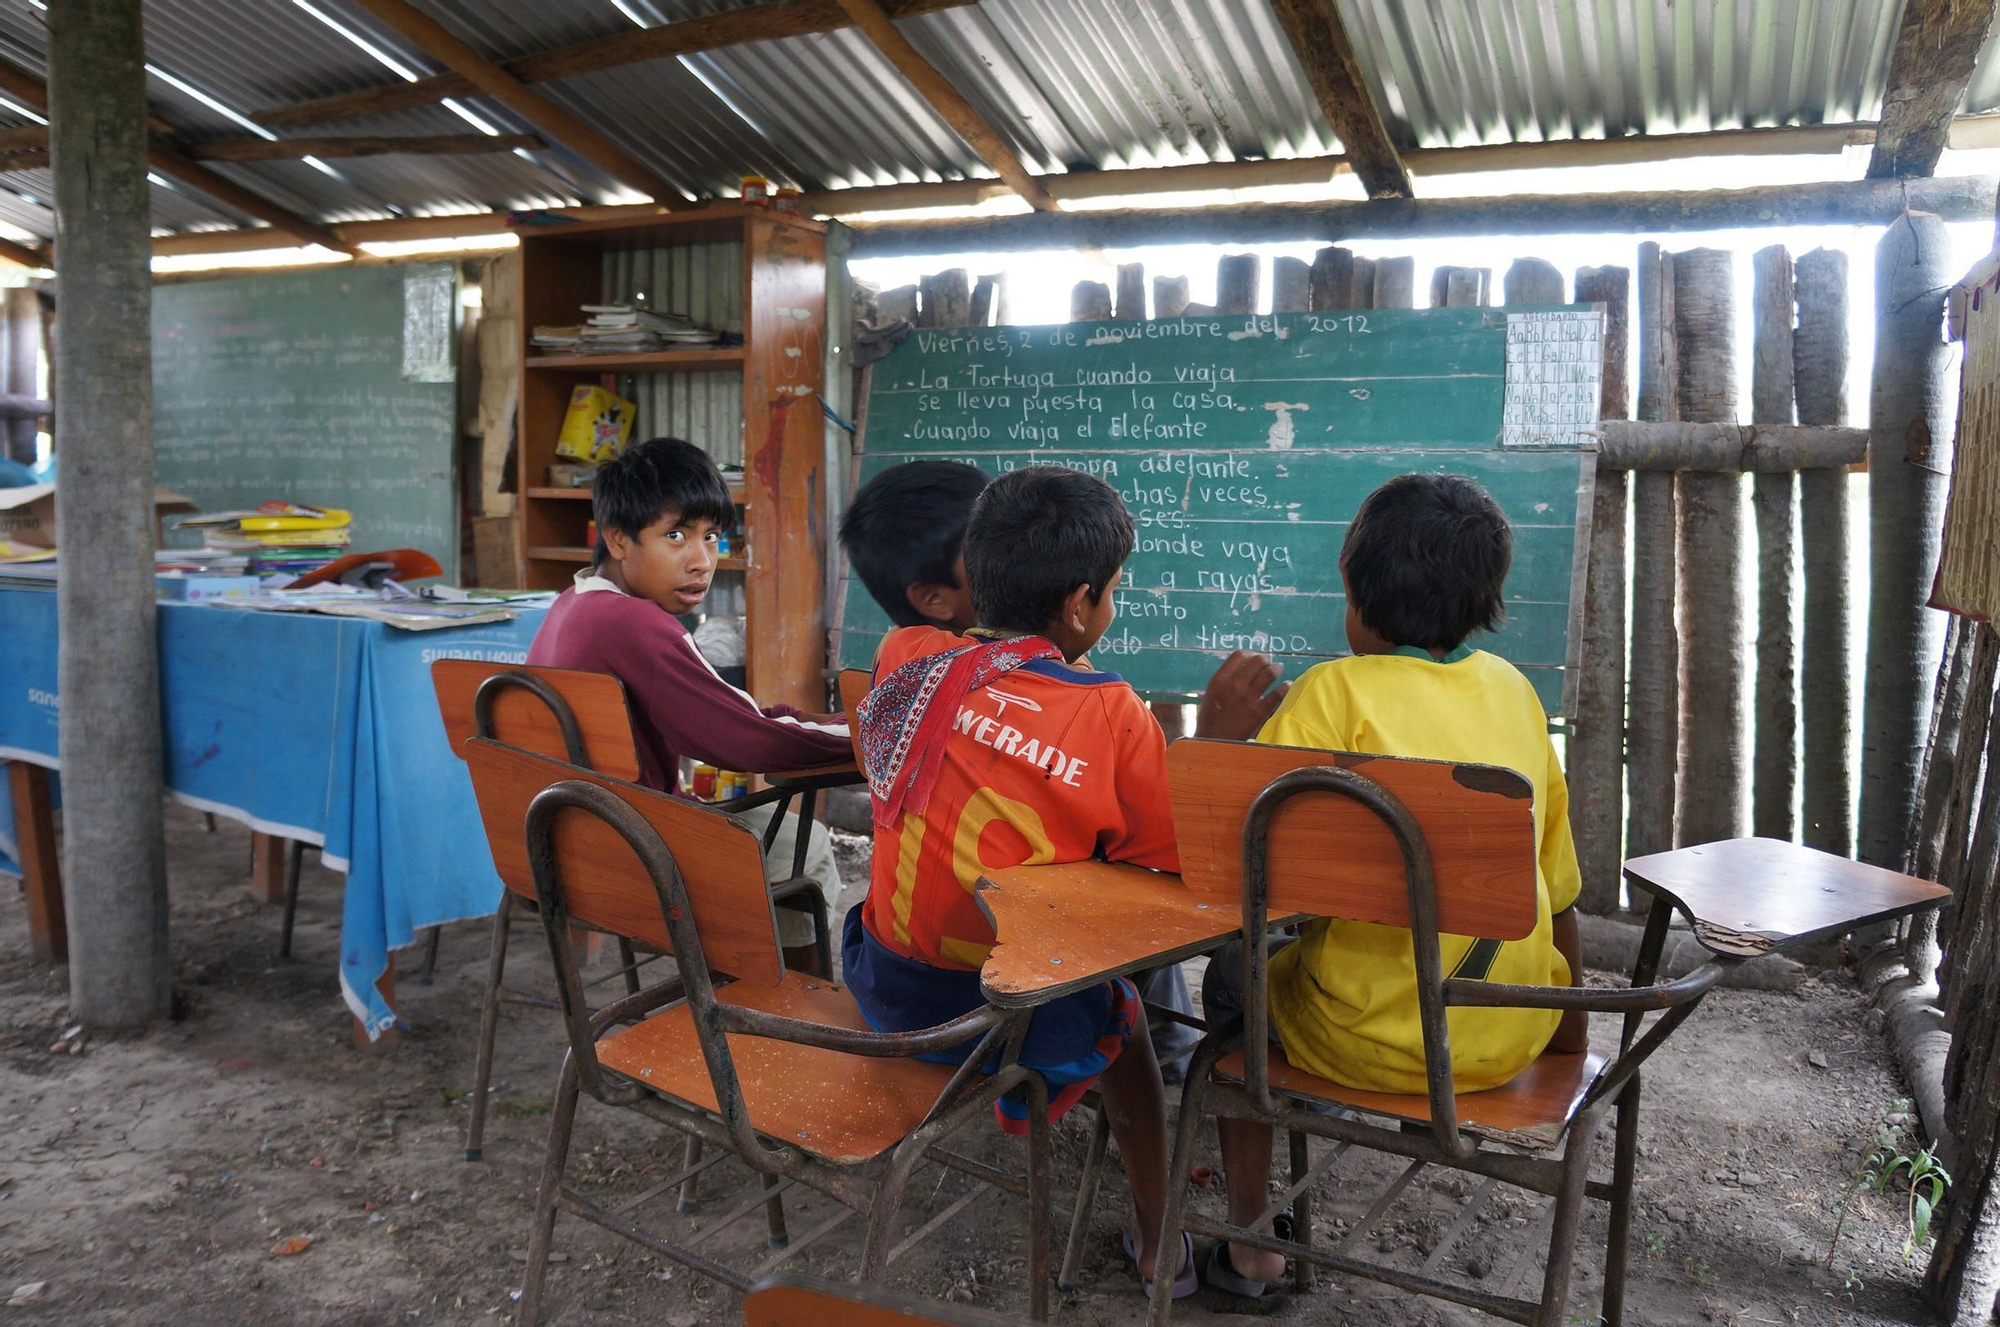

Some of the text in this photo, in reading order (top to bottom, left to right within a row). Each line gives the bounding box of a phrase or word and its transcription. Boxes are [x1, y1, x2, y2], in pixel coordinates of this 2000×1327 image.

[918, 314, 1371, 357] Viernes, 2 de noviembre del 2012
[969, 364, 1054, 399] Tortuga
[1077, 362, 1151, 386] cuando
[1174, 362, 1235, 392] viaja
[919, 394, 941, 411] se
[957, 391, 1010, 410] lleva
[1023, 389, 1102, 421] puesta
[1132, 389, 1155, 410] la
[1008, 420, 1059, 448] viaja
[1077, 415, 1092, 438] el
[1111, 413, 1207, 440] Elefante
[996, 454, 1015, 472] la
[1139, 452, 1259, 480] adelante.
[1200, 484, 1267, 504] veces
[1221, 541, 1291, 572] vaya
[1161, 571, 1175, 589] a
[1088, 624, 1311, 663] odo el tiempo.
